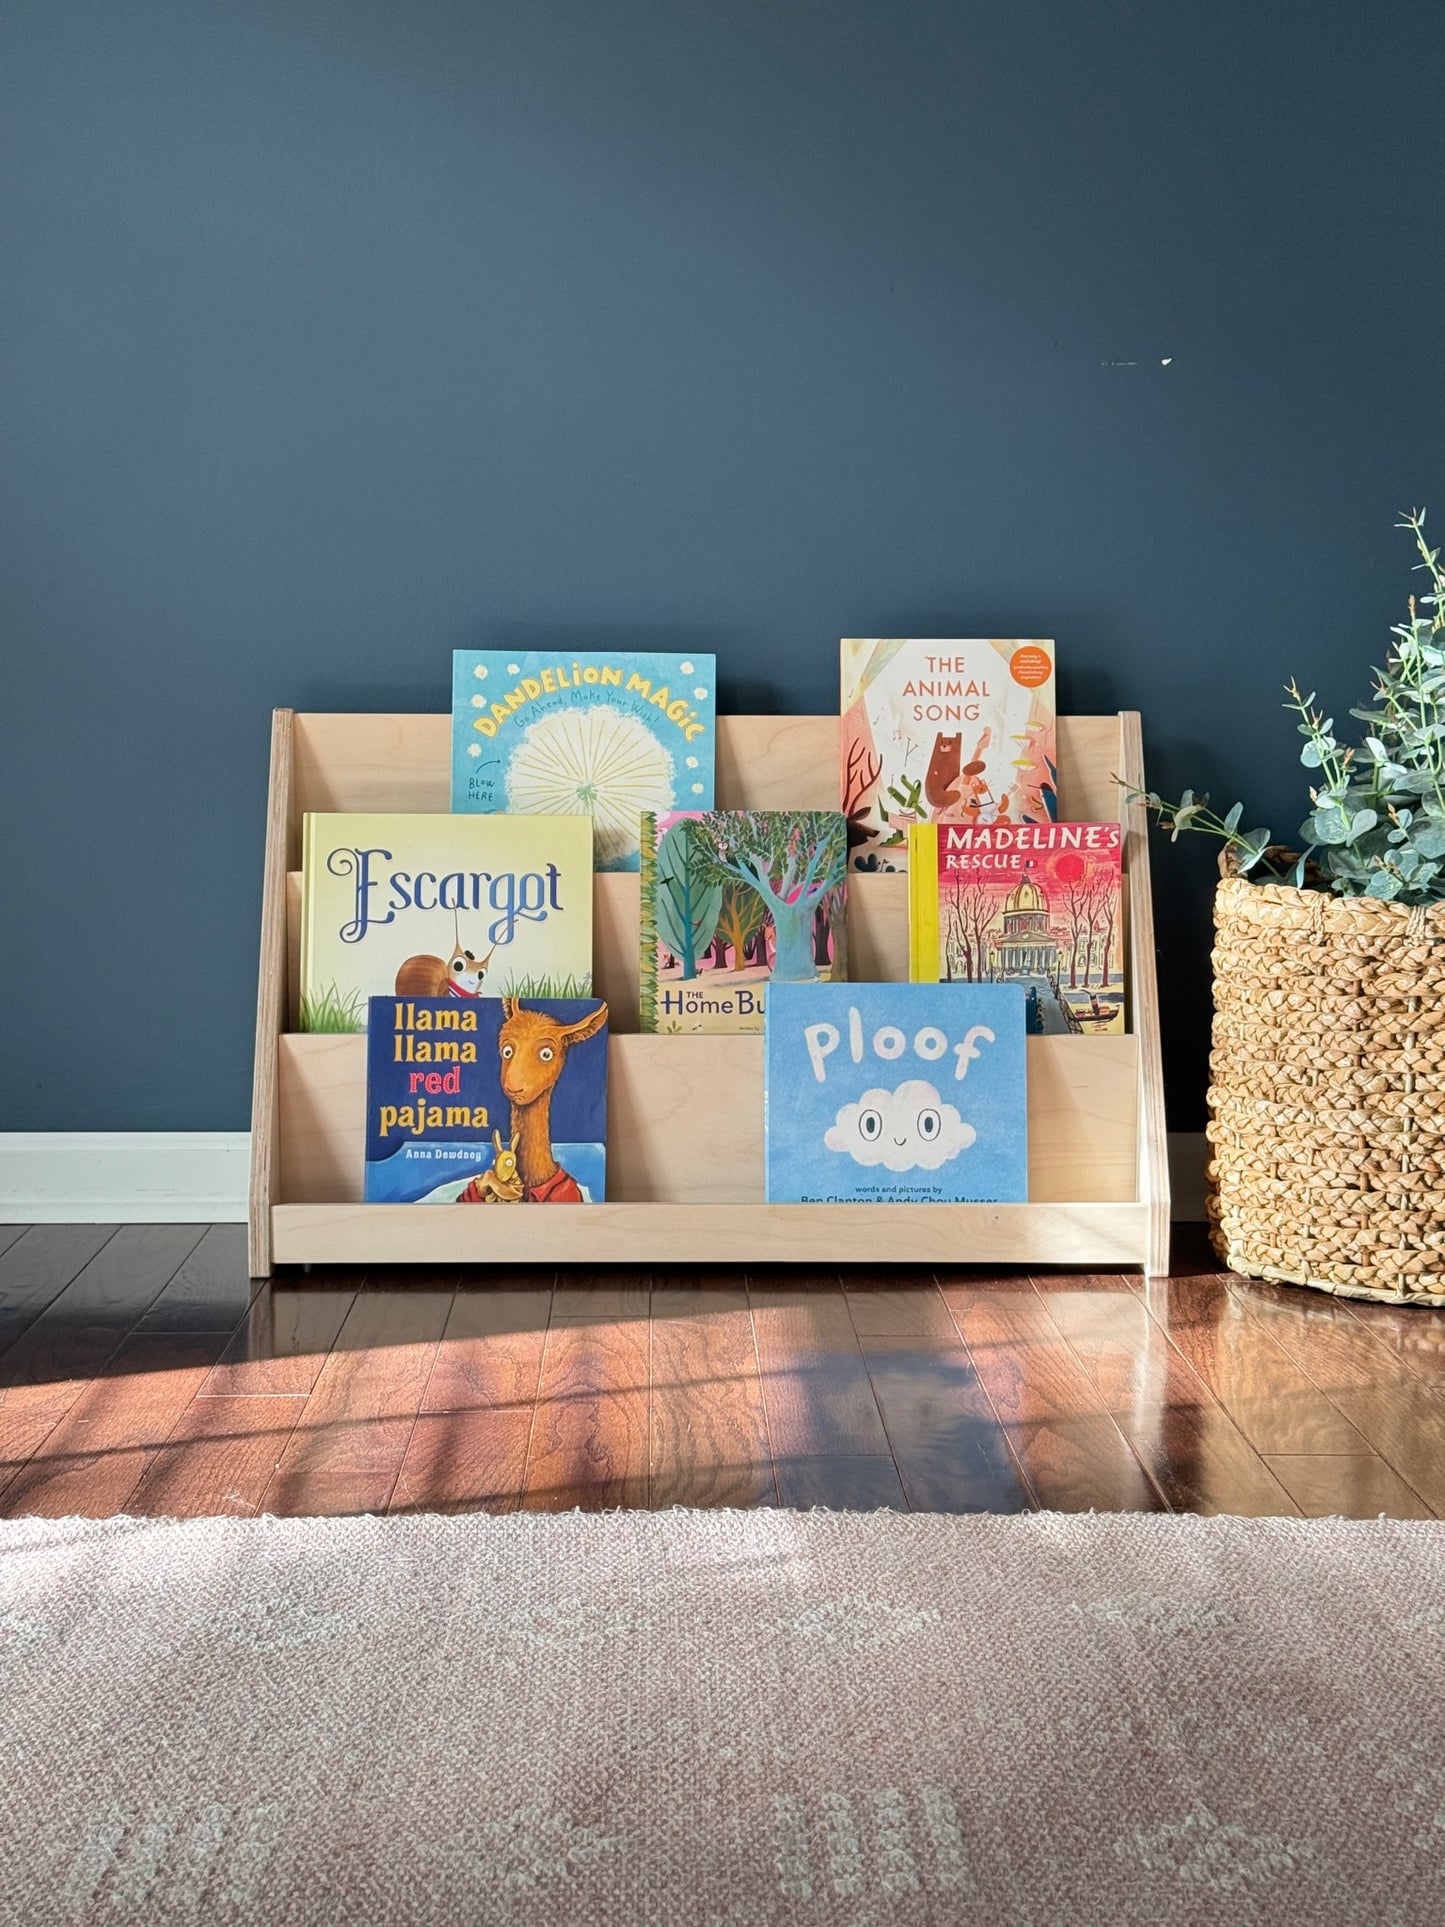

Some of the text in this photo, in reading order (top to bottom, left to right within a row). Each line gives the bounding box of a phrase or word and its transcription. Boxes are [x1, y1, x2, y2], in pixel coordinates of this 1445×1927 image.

[925, 656, 965, 673] THE
[902, 680, 990, 697] ANIMAL
[513, 715, 530, 728] Go
[571, 689, 601, 701] Make
[606, 689, 627, 707] Your
[913, 703, 981, 721] SONG
[469, 777, 495, 789] BLOW
[468, 790, 493, 801] HERE
[946, 854, 1021, 869] RESCUE
[327, 847, 564, 945] Escargot
[660, 990, 733, 1015] Home
[686, 991, 704, 999] THE
[394, 1002, 478, 1032] llama
[393, 1034, 478, 1063] llama
[804, 1006, 996, 1083] ploof
[409, 1065, 461, 1095] red
[379, 1098, 489, 1137] pajama
[406, 1149, 482, 1161] Anna Dewdney
[881, 1185, 897, 1193] and
[899, 1186, 931, 1194] pictures
[932, 1186, 943, 1195] by
